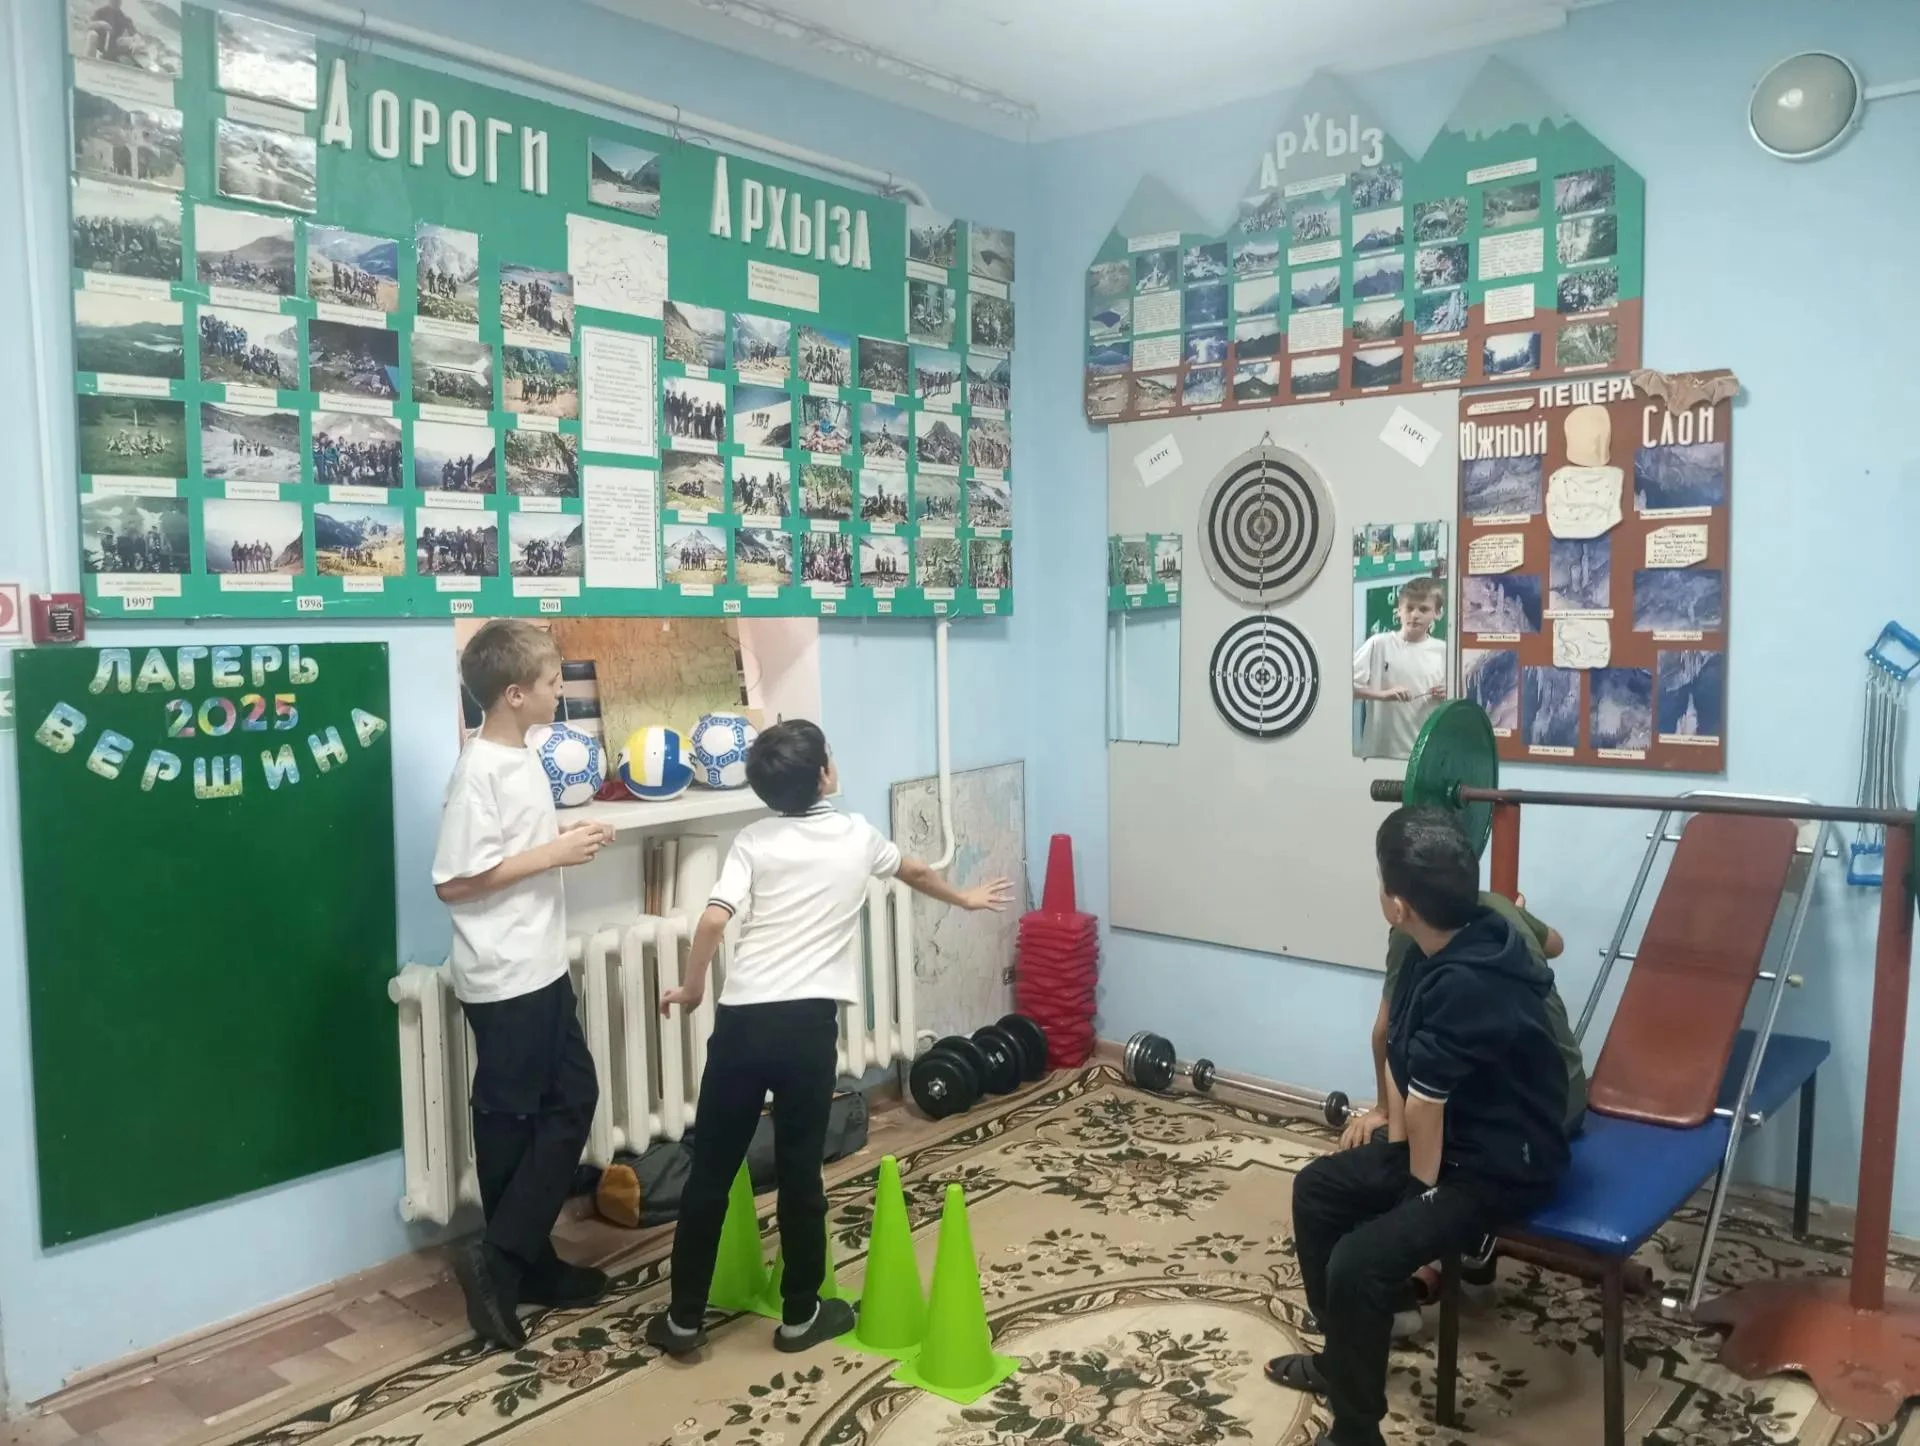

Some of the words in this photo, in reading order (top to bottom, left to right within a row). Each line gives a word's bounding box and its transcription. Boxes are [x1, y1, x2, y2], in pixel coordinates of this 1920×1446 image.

[1259, 112, 1384, 191] АРХЫЗ
[1539, 379, 1635, 408] ПЕЩЕРА
[1460, 414, 1547, 460] ЮЖНЫЙ
[1643, 405, 1715, 448] СЛОН
[125, 597, 152, 609] 1997
[298, 598, 322, 609] 1998
[452, 602, 472, 611] 1999
[541, 602, 559, 611] 2001
[88, 644, 319, 695] ЛАГЕРЬ
[164, 693, 299, 738] 2025
[34, 701, 388, 799] ВЕРШИНА
